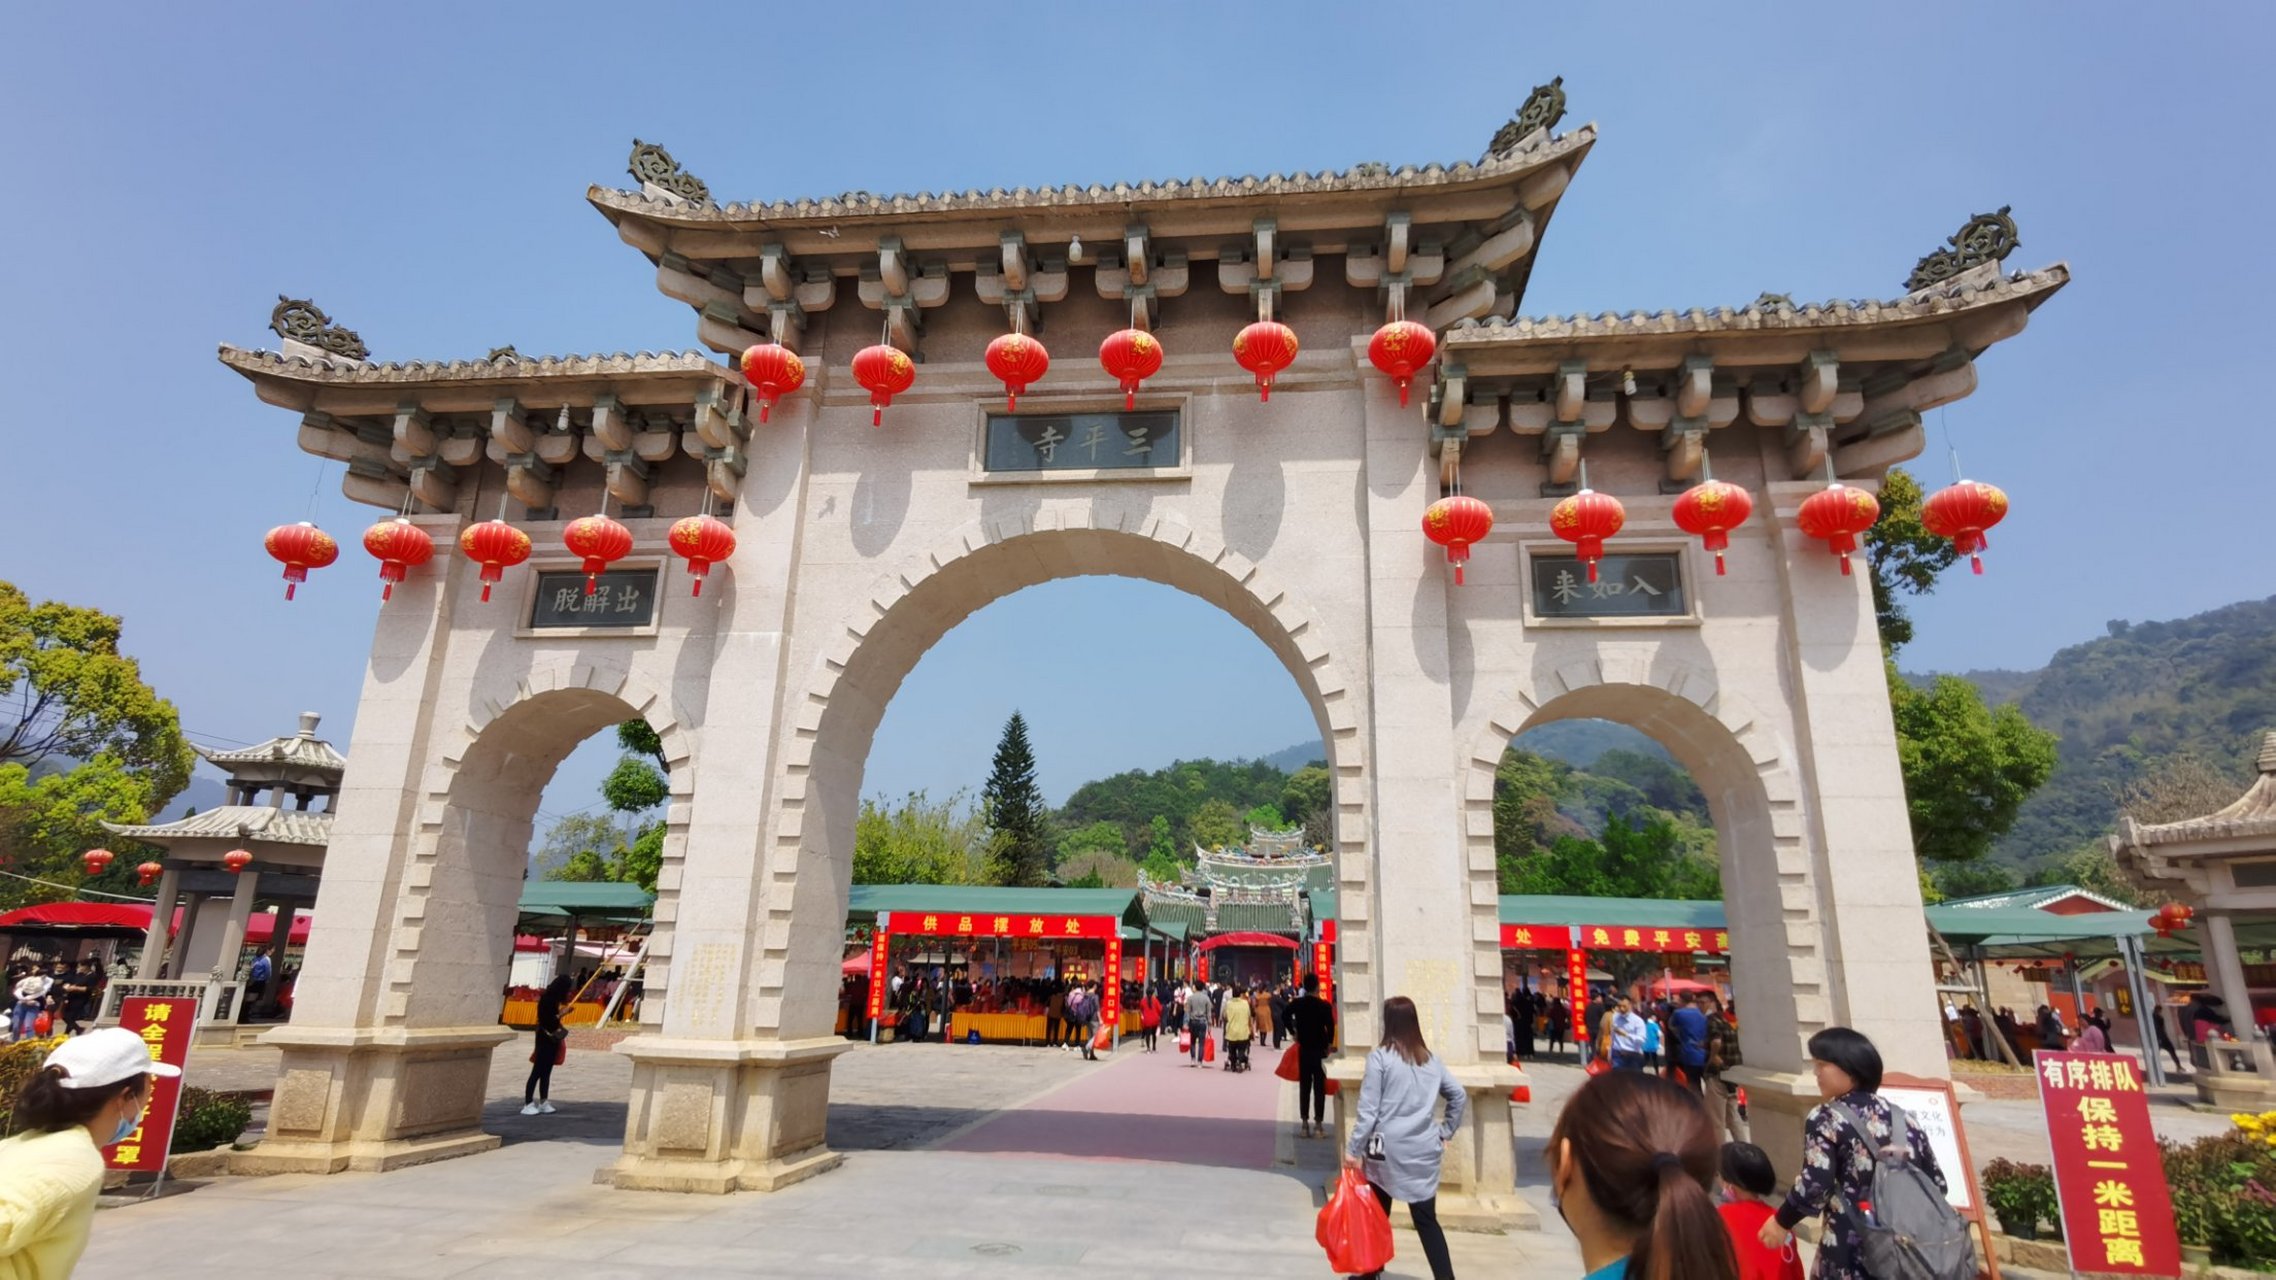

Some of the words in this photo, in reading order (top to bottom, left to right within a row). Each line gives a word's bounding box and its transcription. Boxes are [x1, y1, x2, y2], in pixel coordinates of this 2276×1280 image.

[923, 915, 1081, 934] 供品摆放处
[2041, 1058, 2139, 1092] 有序排队
[2077, 1096, 2145, 1267] 保持一米距离
